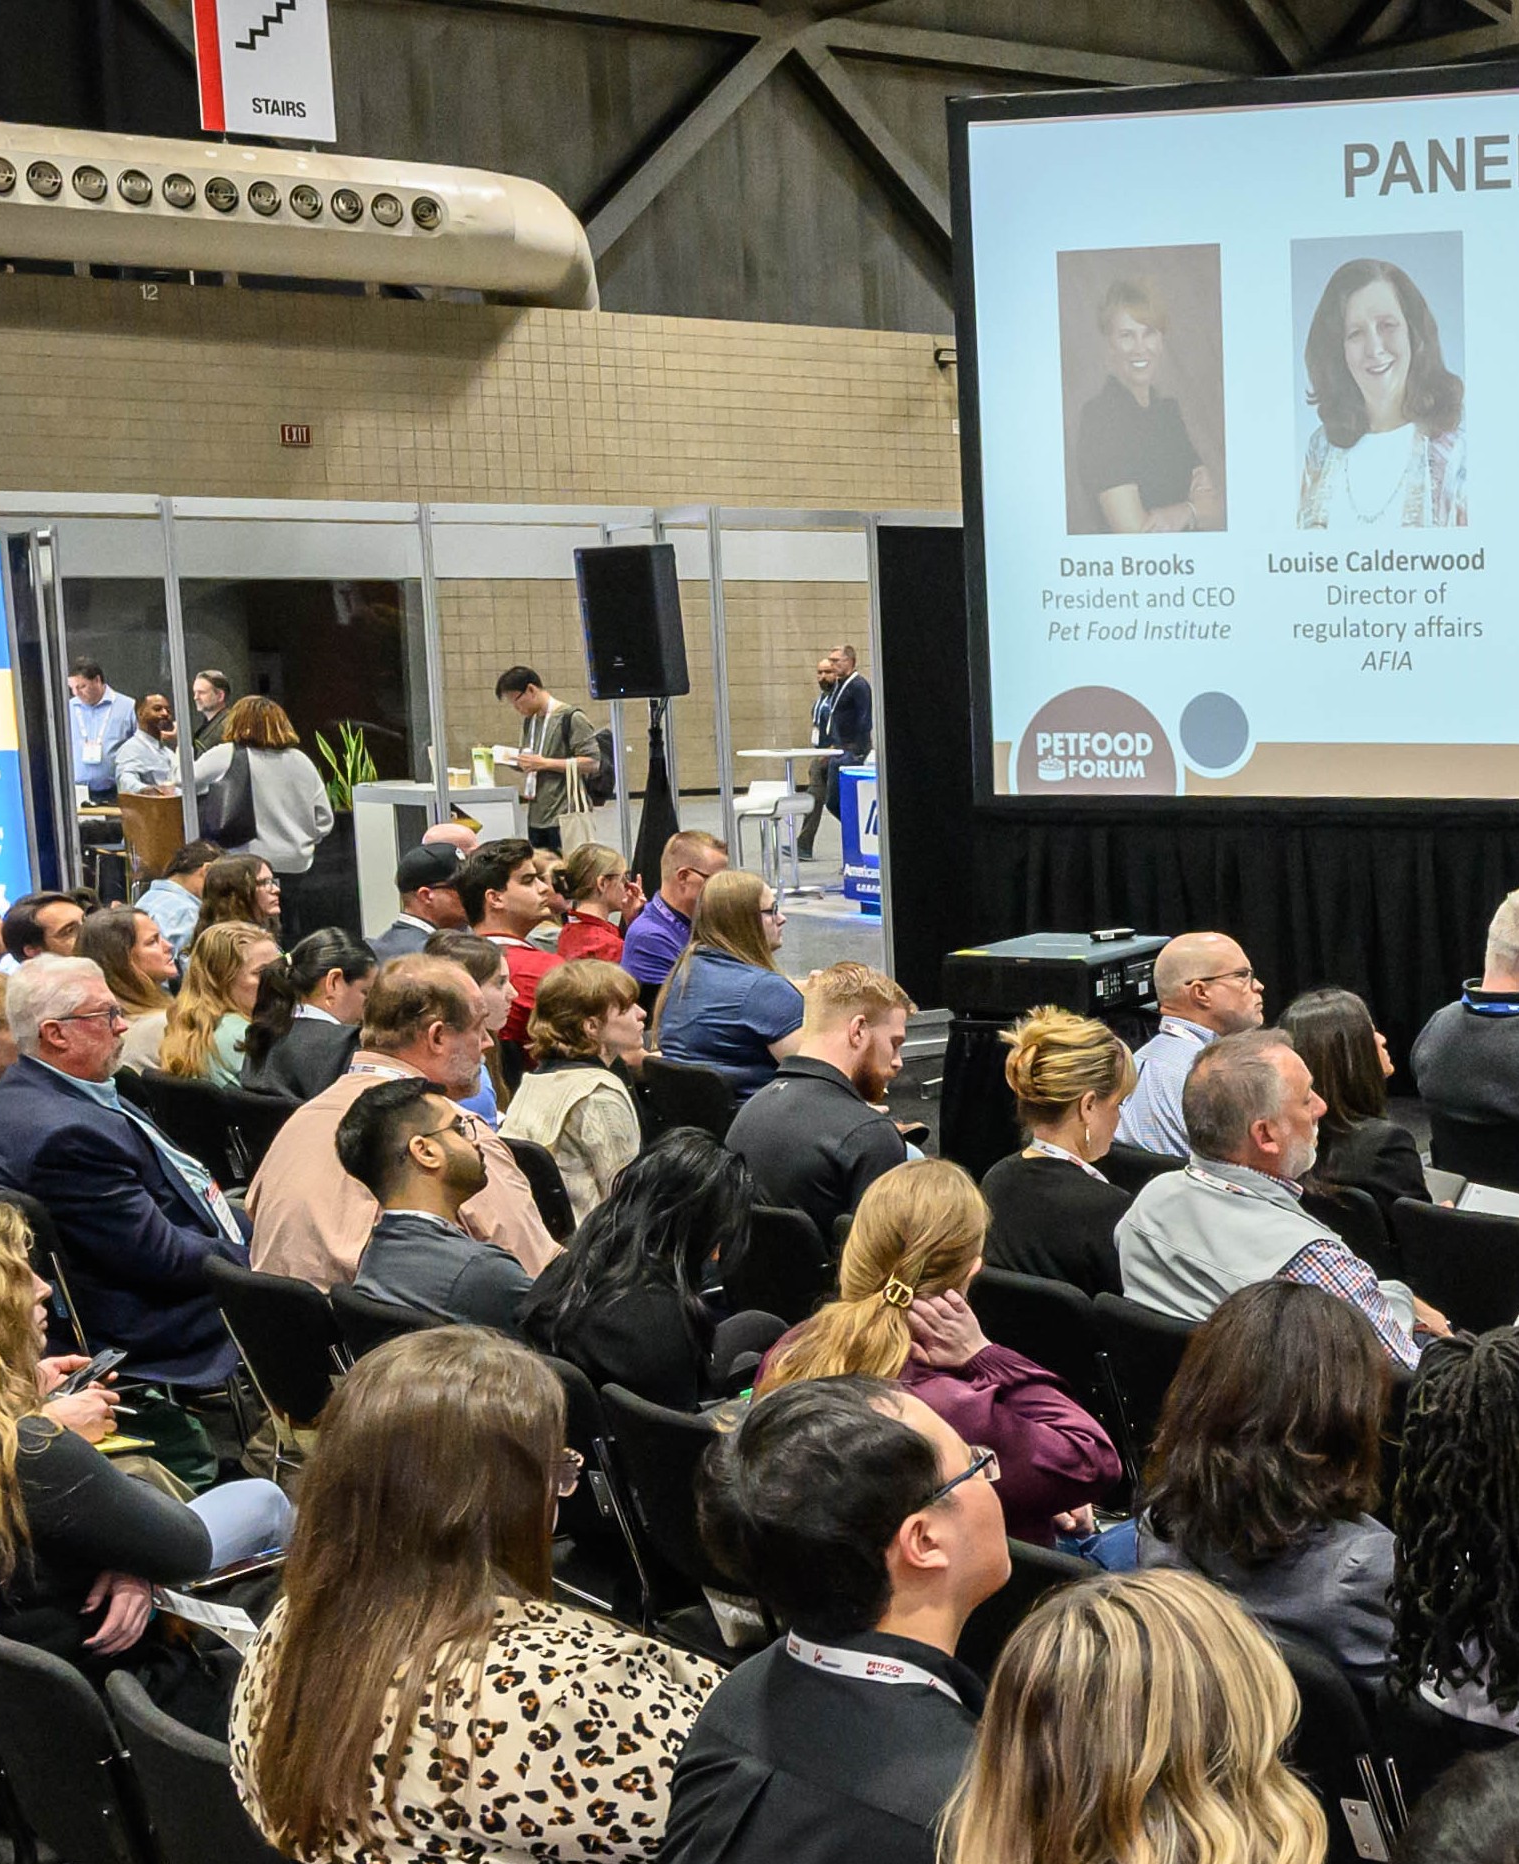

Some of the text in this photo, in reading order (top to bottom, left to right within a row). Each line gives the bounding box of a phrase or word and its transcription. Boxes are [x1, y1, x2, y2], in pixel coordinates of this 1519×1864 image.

[252, 97, 307, 118] STAIRS
[1060, 553, 1195, 578] Dana Brooks
[1268, 547, 1485, 573] Louise Calderwood
[1042, 586, 1236, 610] President and CEO
[1327, 582, 1448, 606] Director of
[1048, 618, 1231, 642] Pet Food Institute
[1293, 615, 1484, 643] regulatory affairs
[1360, 650, 1414, 672] AFIA
[1036, 732, 1154, 757] PETFOOD
[1068, 759, 1146, 779] FORUM
[867, 1660, 904, 1675] PETFOOD
